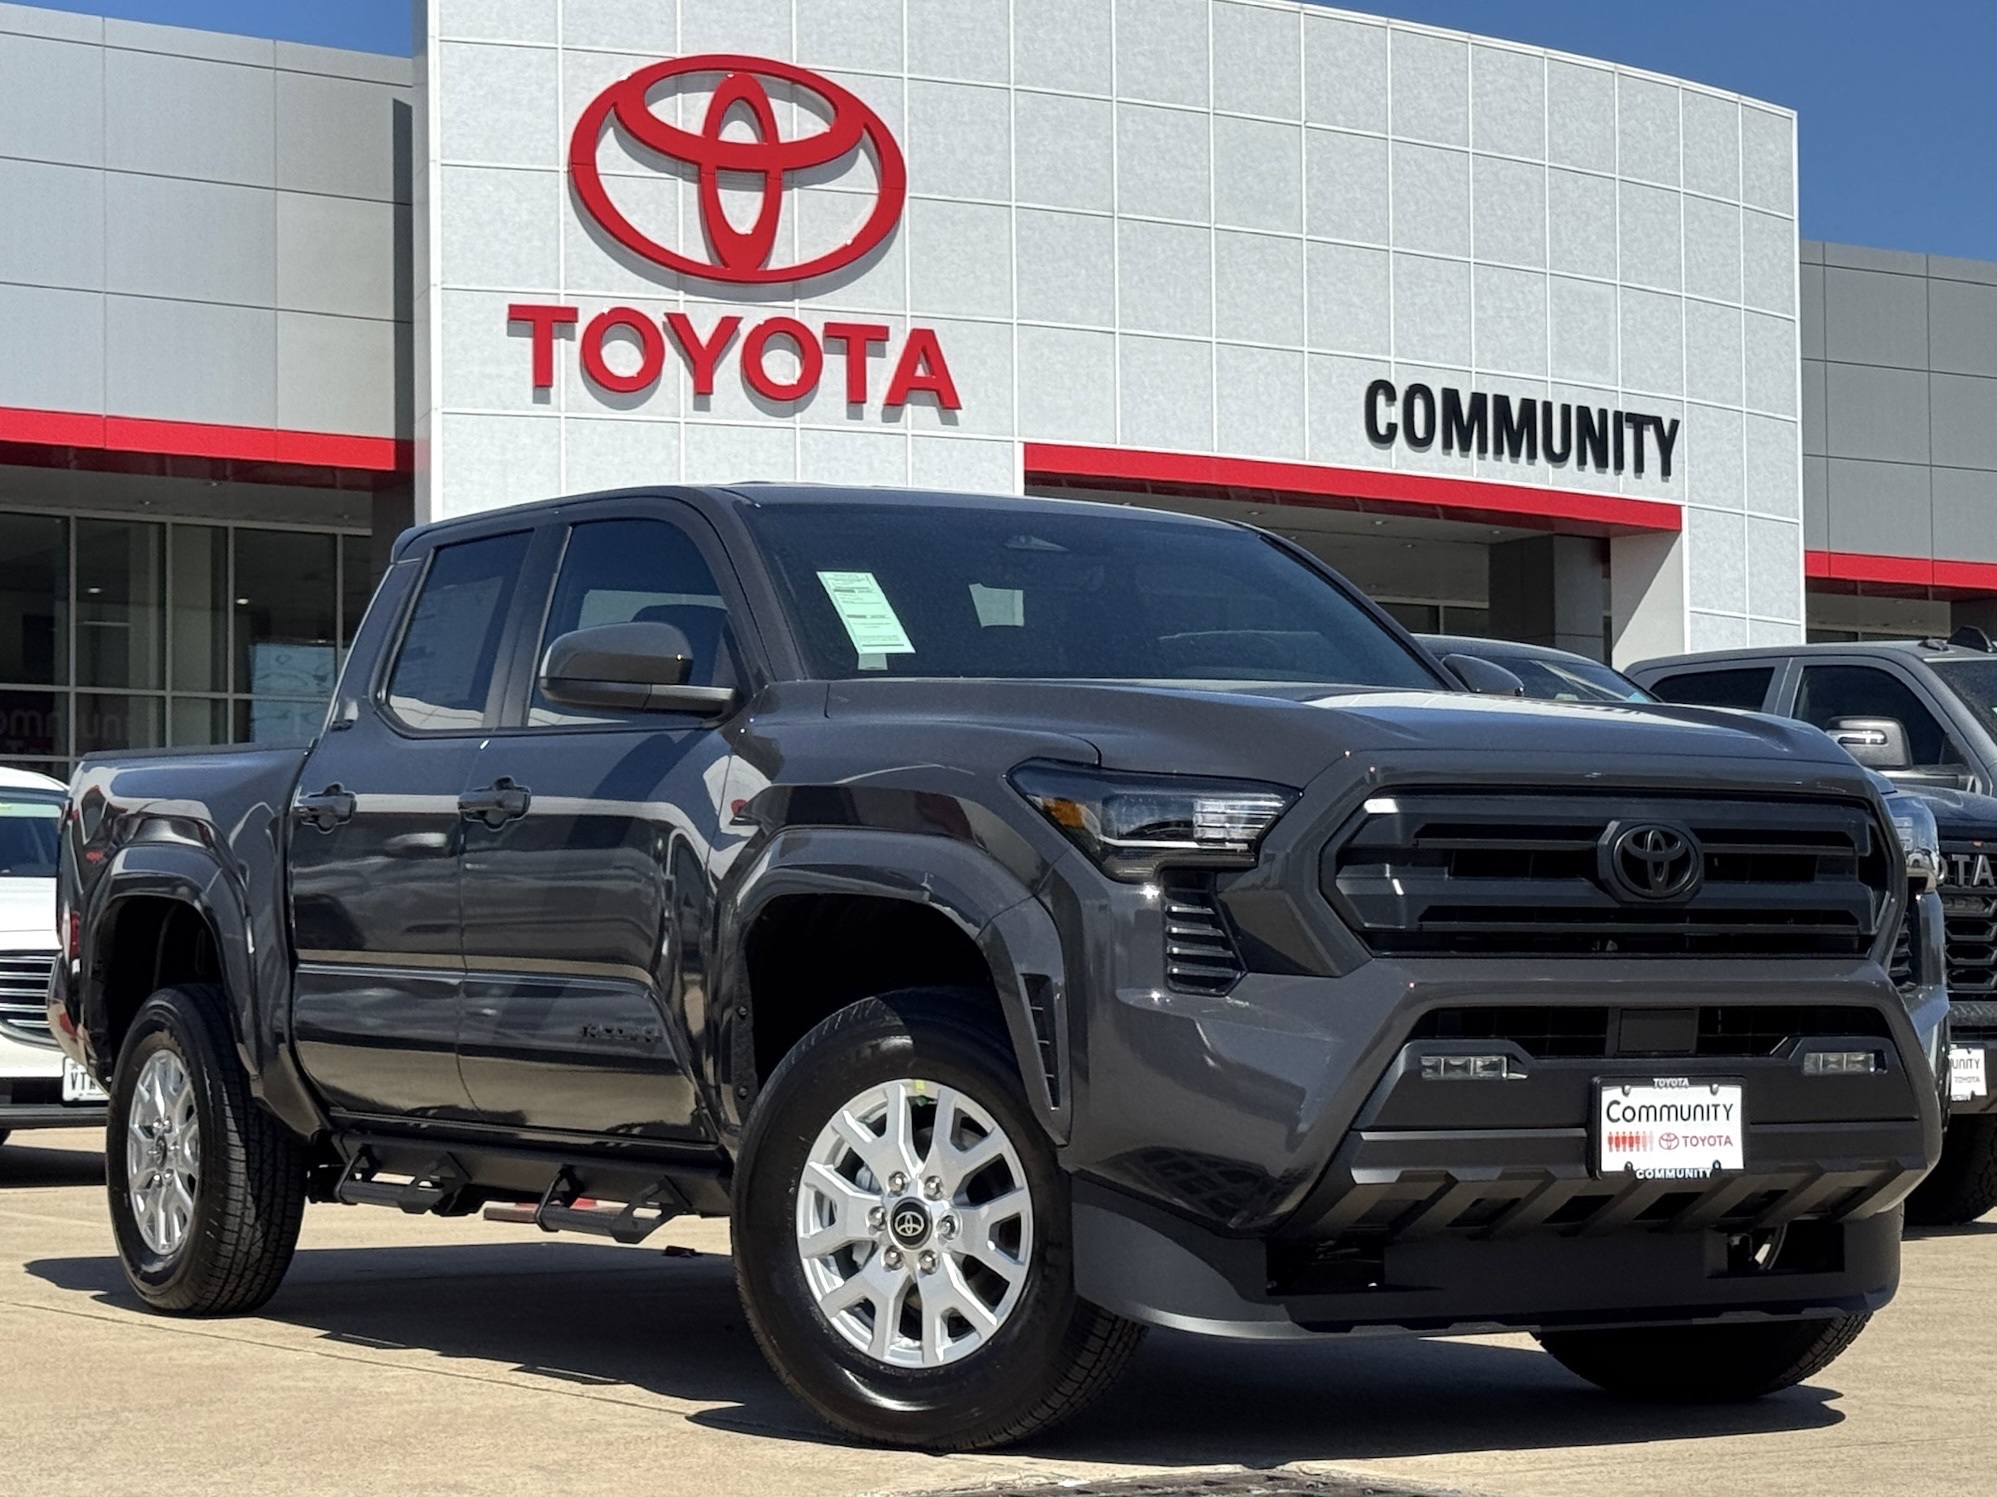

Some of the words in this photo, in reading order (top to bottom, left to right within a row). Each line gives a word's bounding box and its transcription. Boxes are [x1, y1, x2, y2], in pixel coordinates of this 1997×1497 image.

[508, 303, 962, 411] TOYOTA
[1364, 379, 1680, 478] COMMUNITY
[1652, 1078, 1690, 1088] TOYOTA
[1681, 1135, 1734, 1147] TOYOTA
[1635, 1168, 1712, 1180] COMMUNITY
